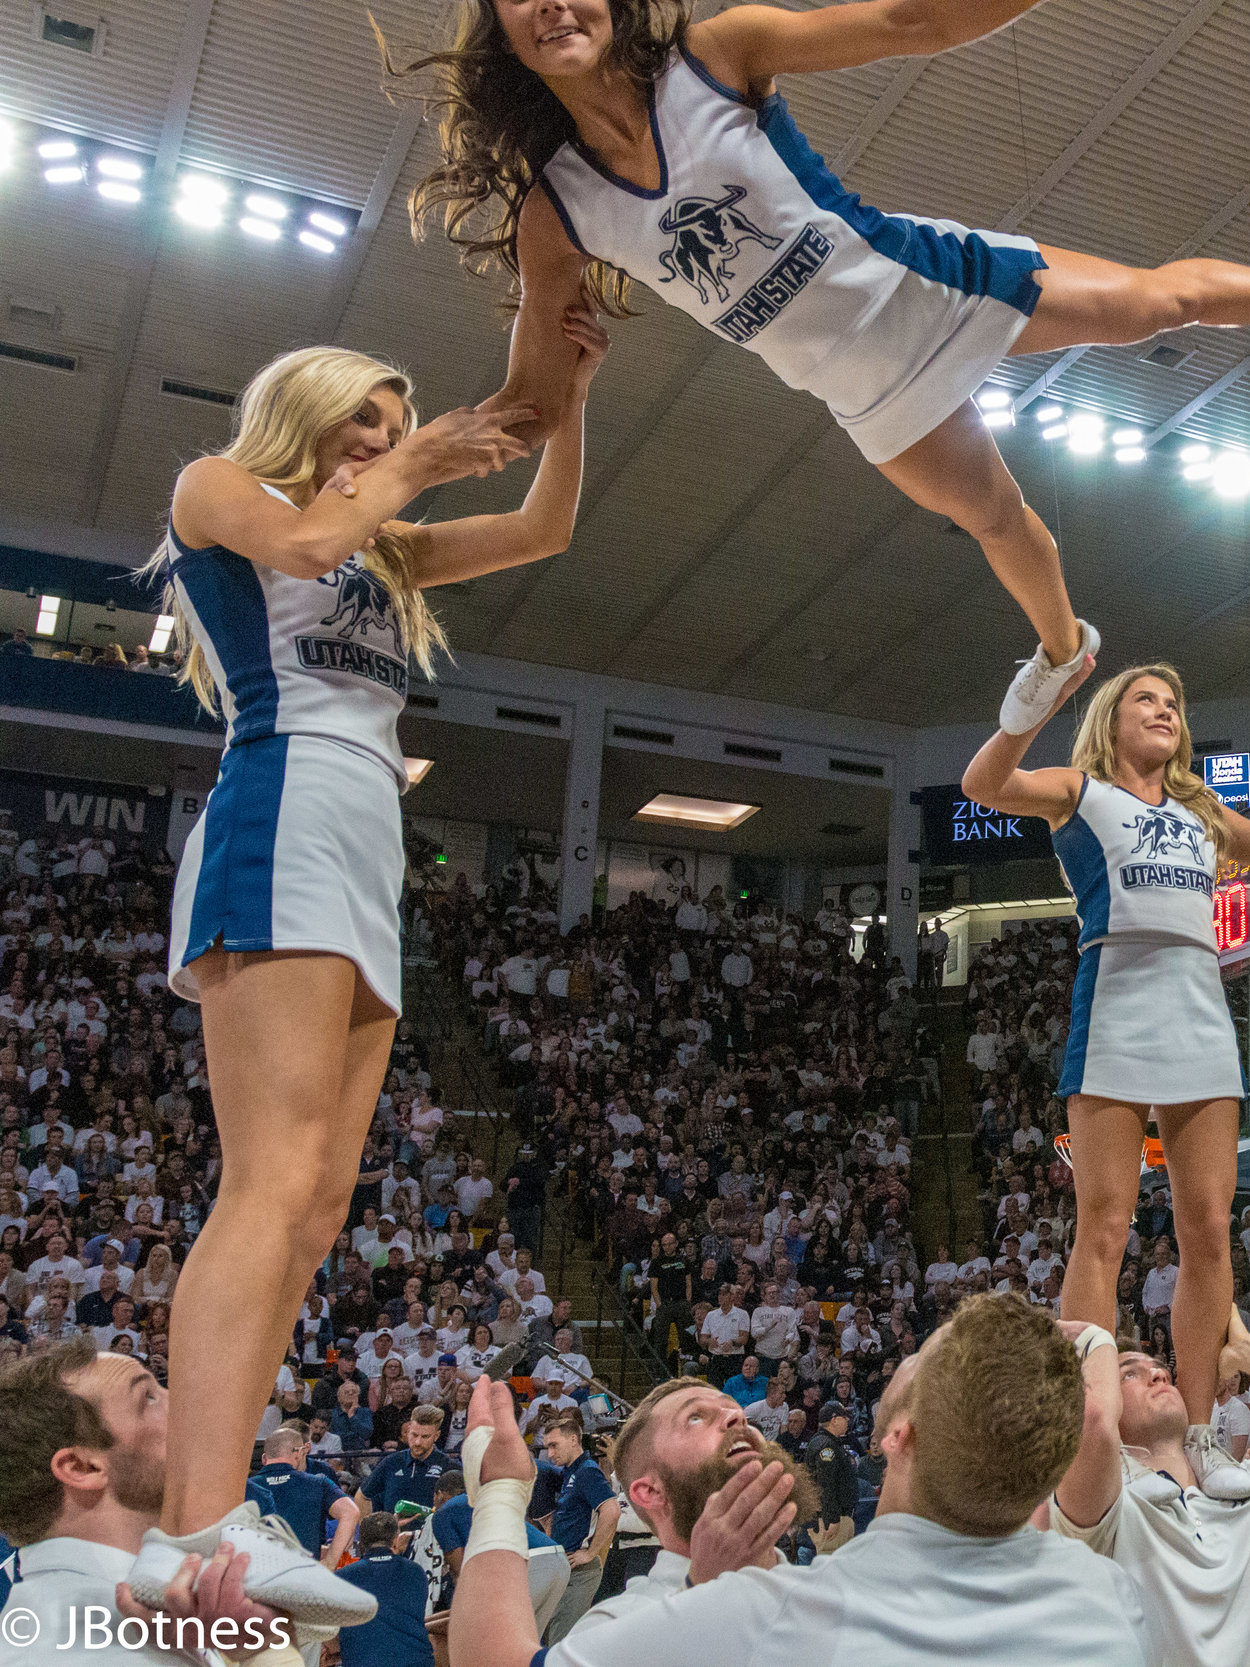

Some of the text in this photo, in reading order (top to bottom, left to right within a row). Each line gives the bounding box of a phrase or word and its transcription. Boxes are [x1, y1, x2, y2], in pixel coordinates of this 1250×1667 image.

[756, 222, 834, 307] STATE
[296, 637, 374, 680] UTAH
[182, 797, 200, 815] B
[1223, 793, 1249, 804] pepsi
[45, 790, 146, 832] WIN
[953, 801, 1001, 820] ZIO
[952, 818, 1024, 841] BANK
[574, 846, 588, 861] C
[1119, 864, 1174, 889] UTAH
[901, 887, 912, 900] D
